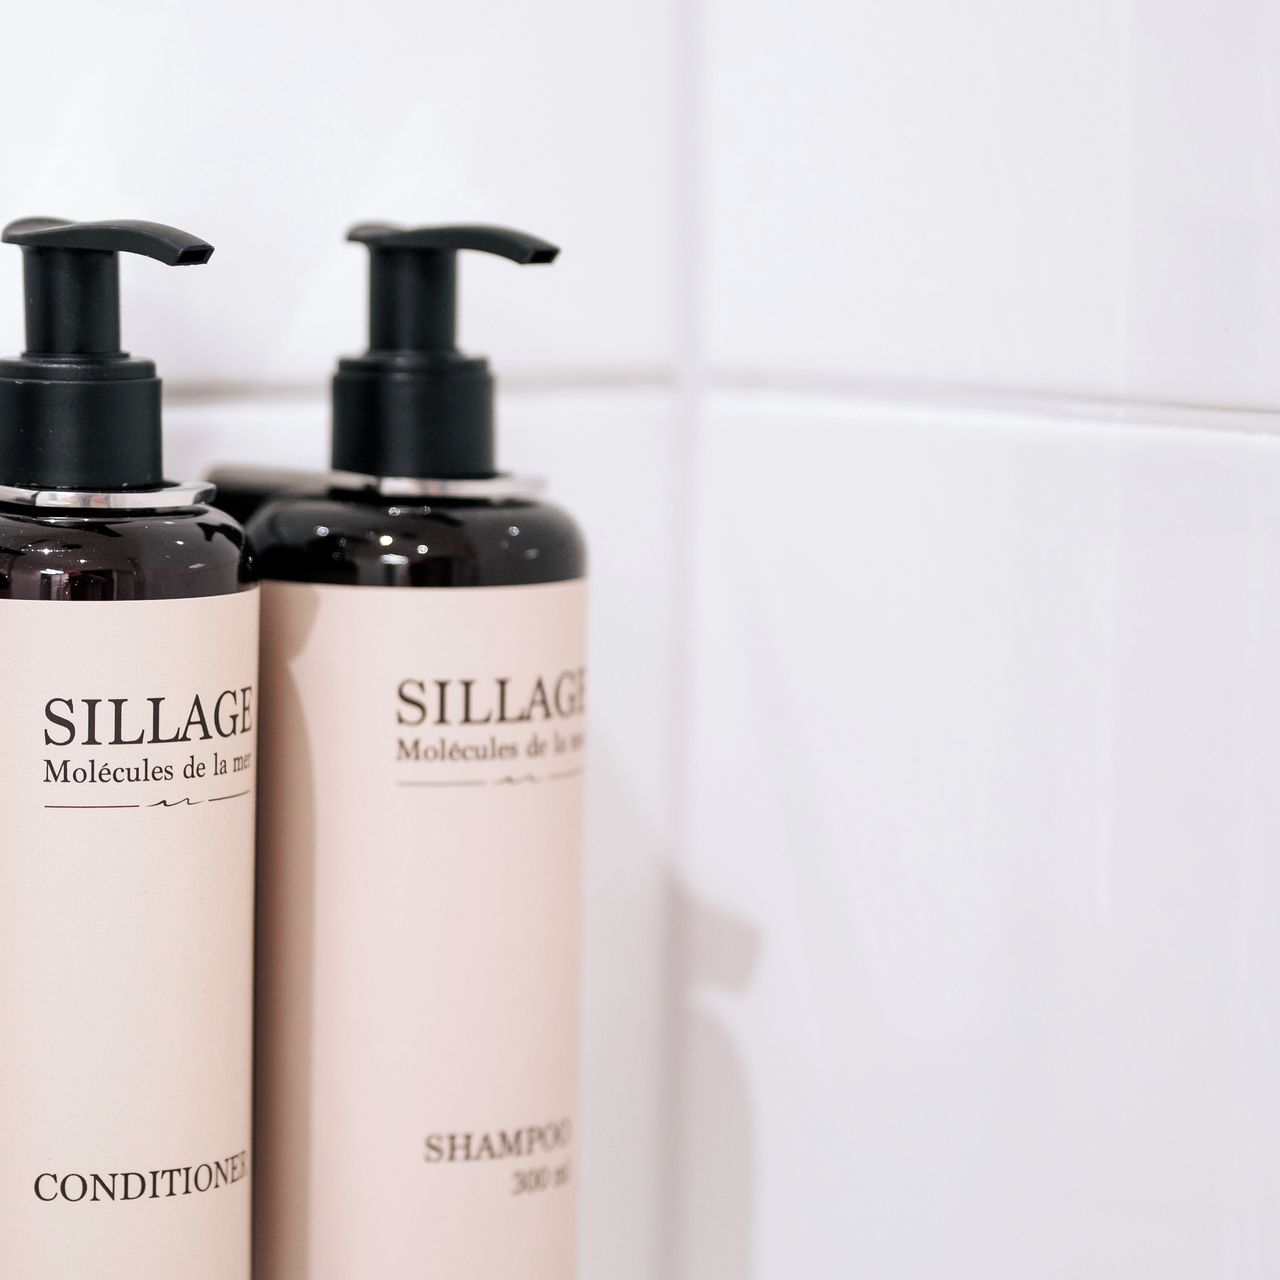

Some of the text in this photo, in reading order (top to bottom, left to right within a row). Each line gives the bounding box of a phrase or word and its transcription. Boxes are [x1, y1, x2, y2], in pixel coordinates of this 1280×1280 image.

[43, 685, 253, 746] SILLAGE
[396, 735, 518, 762] Molécules
[42, 758, 174, 784] Molécules
[183, 755, 206, 779] de
[213, 752, 228, 776] la
